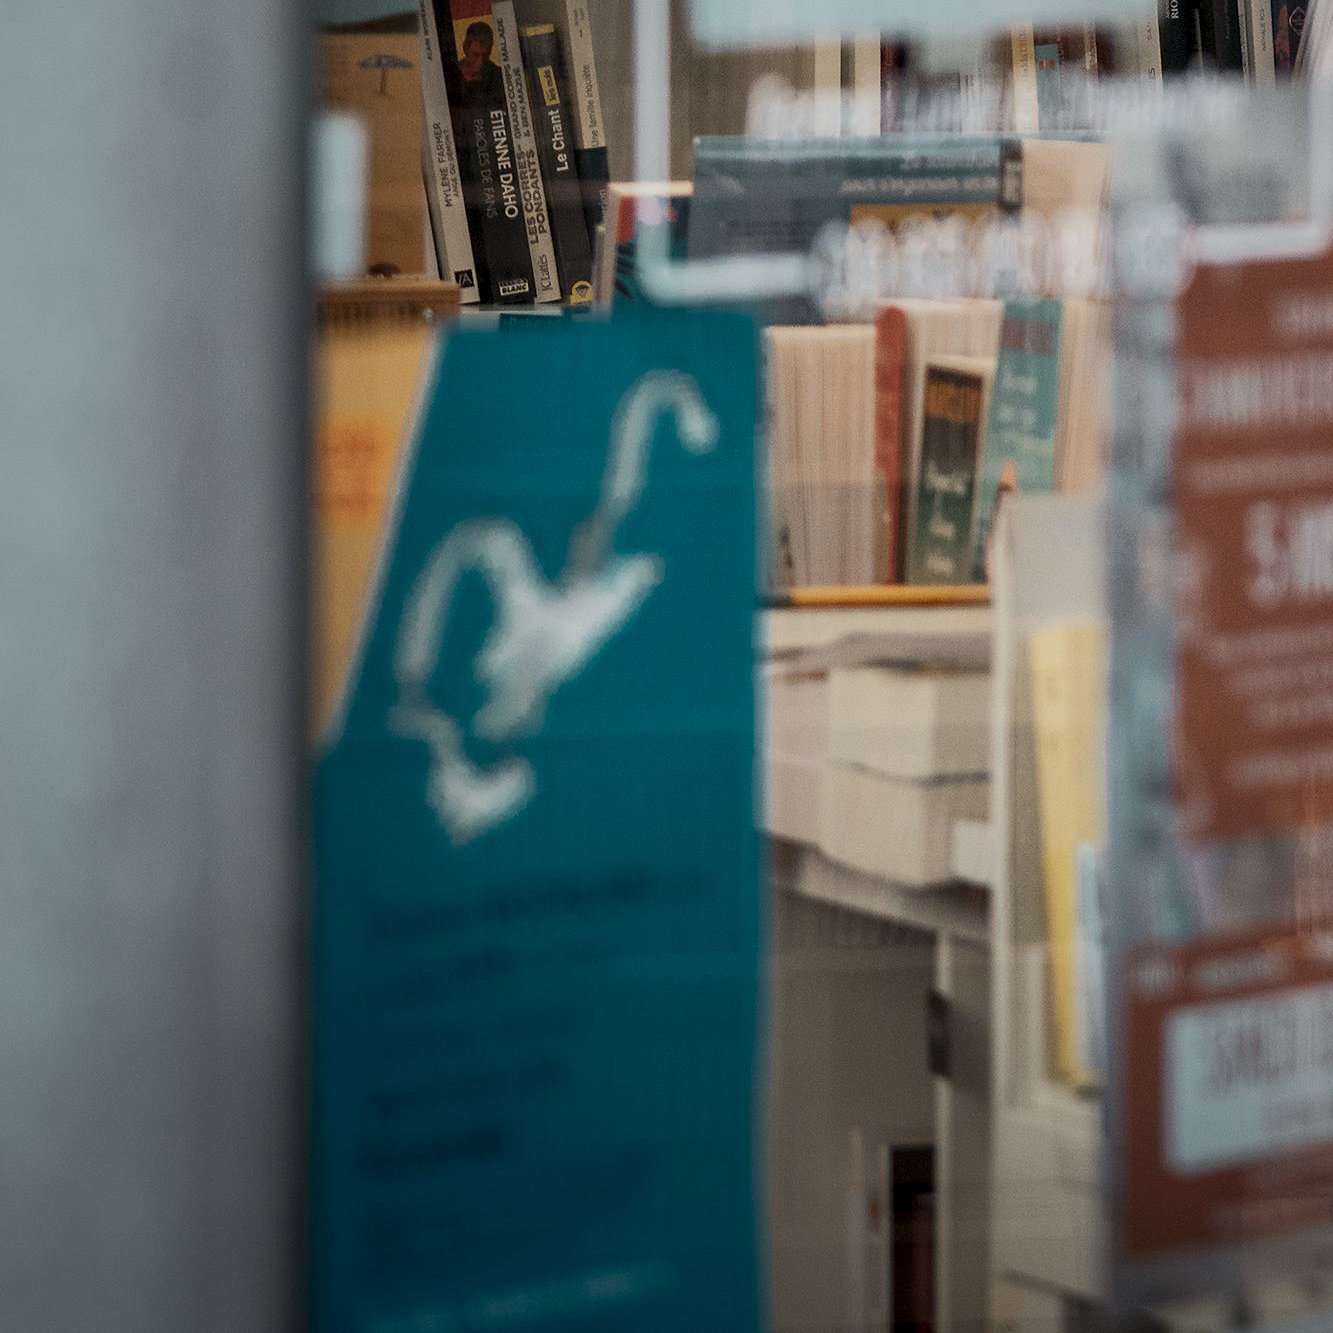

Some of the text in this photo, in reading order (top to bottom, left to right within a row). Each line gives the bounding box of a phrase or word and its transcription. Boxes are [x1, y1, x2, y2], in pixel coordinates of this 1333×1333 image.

[433, 122, 454, 207] MYLÈNE FARMER
[490, 109, 519, 219] ÉTIENNE DAHO
[548, 108, 570, 172] Le Chant
[515, 144, 539, 245] LES CORRES-
[525, 149, 547, 235] PONDANTS
